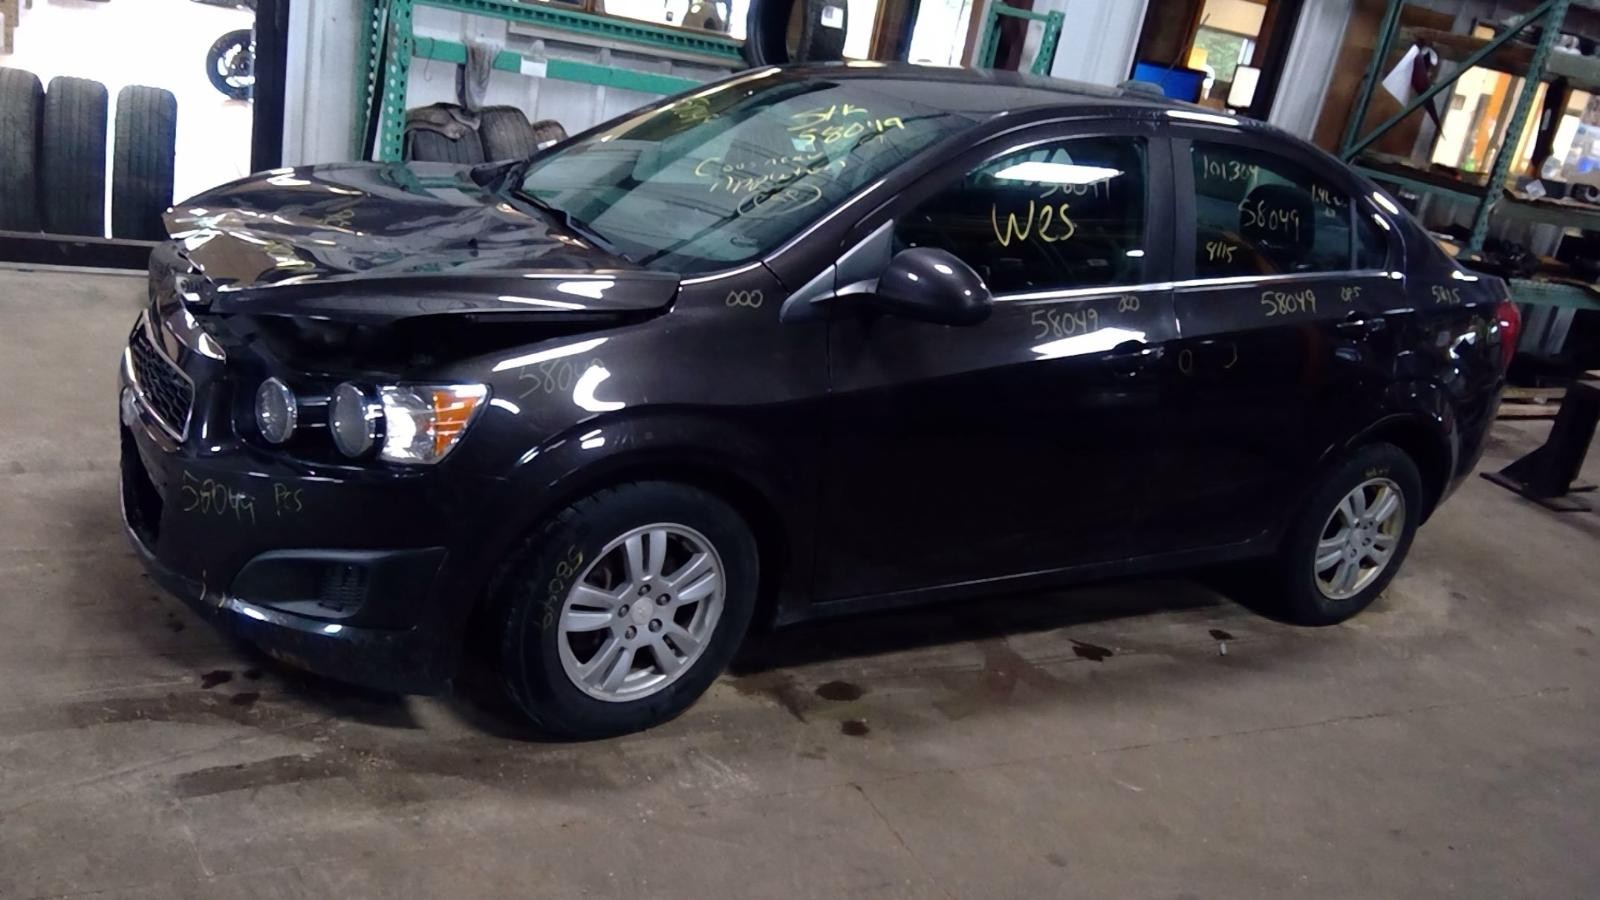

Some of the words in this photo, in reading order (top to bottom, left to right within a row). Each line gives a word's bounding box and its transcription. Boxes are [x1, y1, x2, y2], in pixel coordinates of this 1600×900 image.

[1238, 199, 1300, 242] 58049
[1261, 289, 1317, 317] 58049
[1031, 307, 1099, 340] 58049
